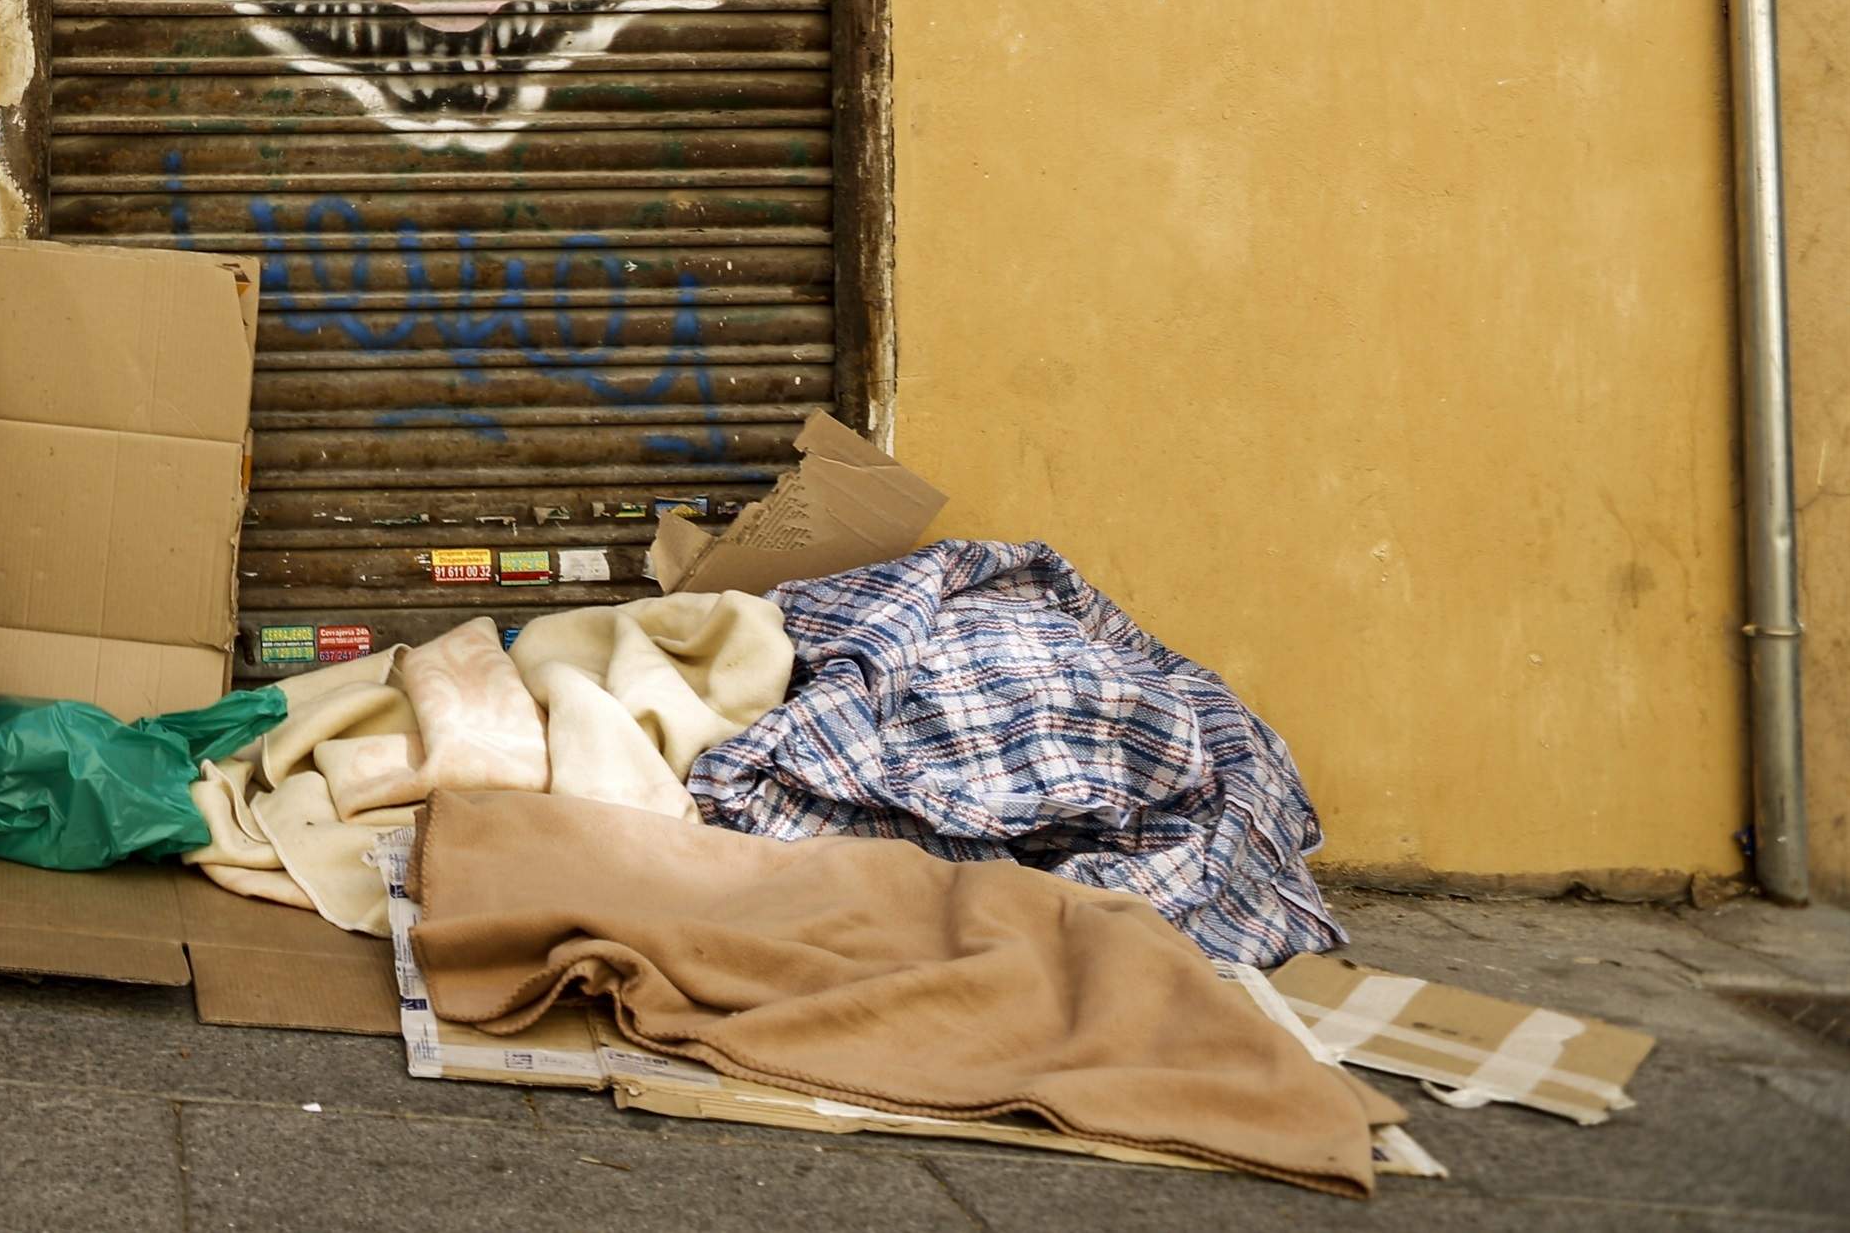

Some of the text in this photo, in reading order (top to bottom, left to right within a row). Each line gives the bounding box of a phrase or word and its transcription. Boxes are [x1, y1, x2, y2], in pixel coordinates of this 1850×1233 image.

[435, 565, 491, 578] 91 611 00 32
